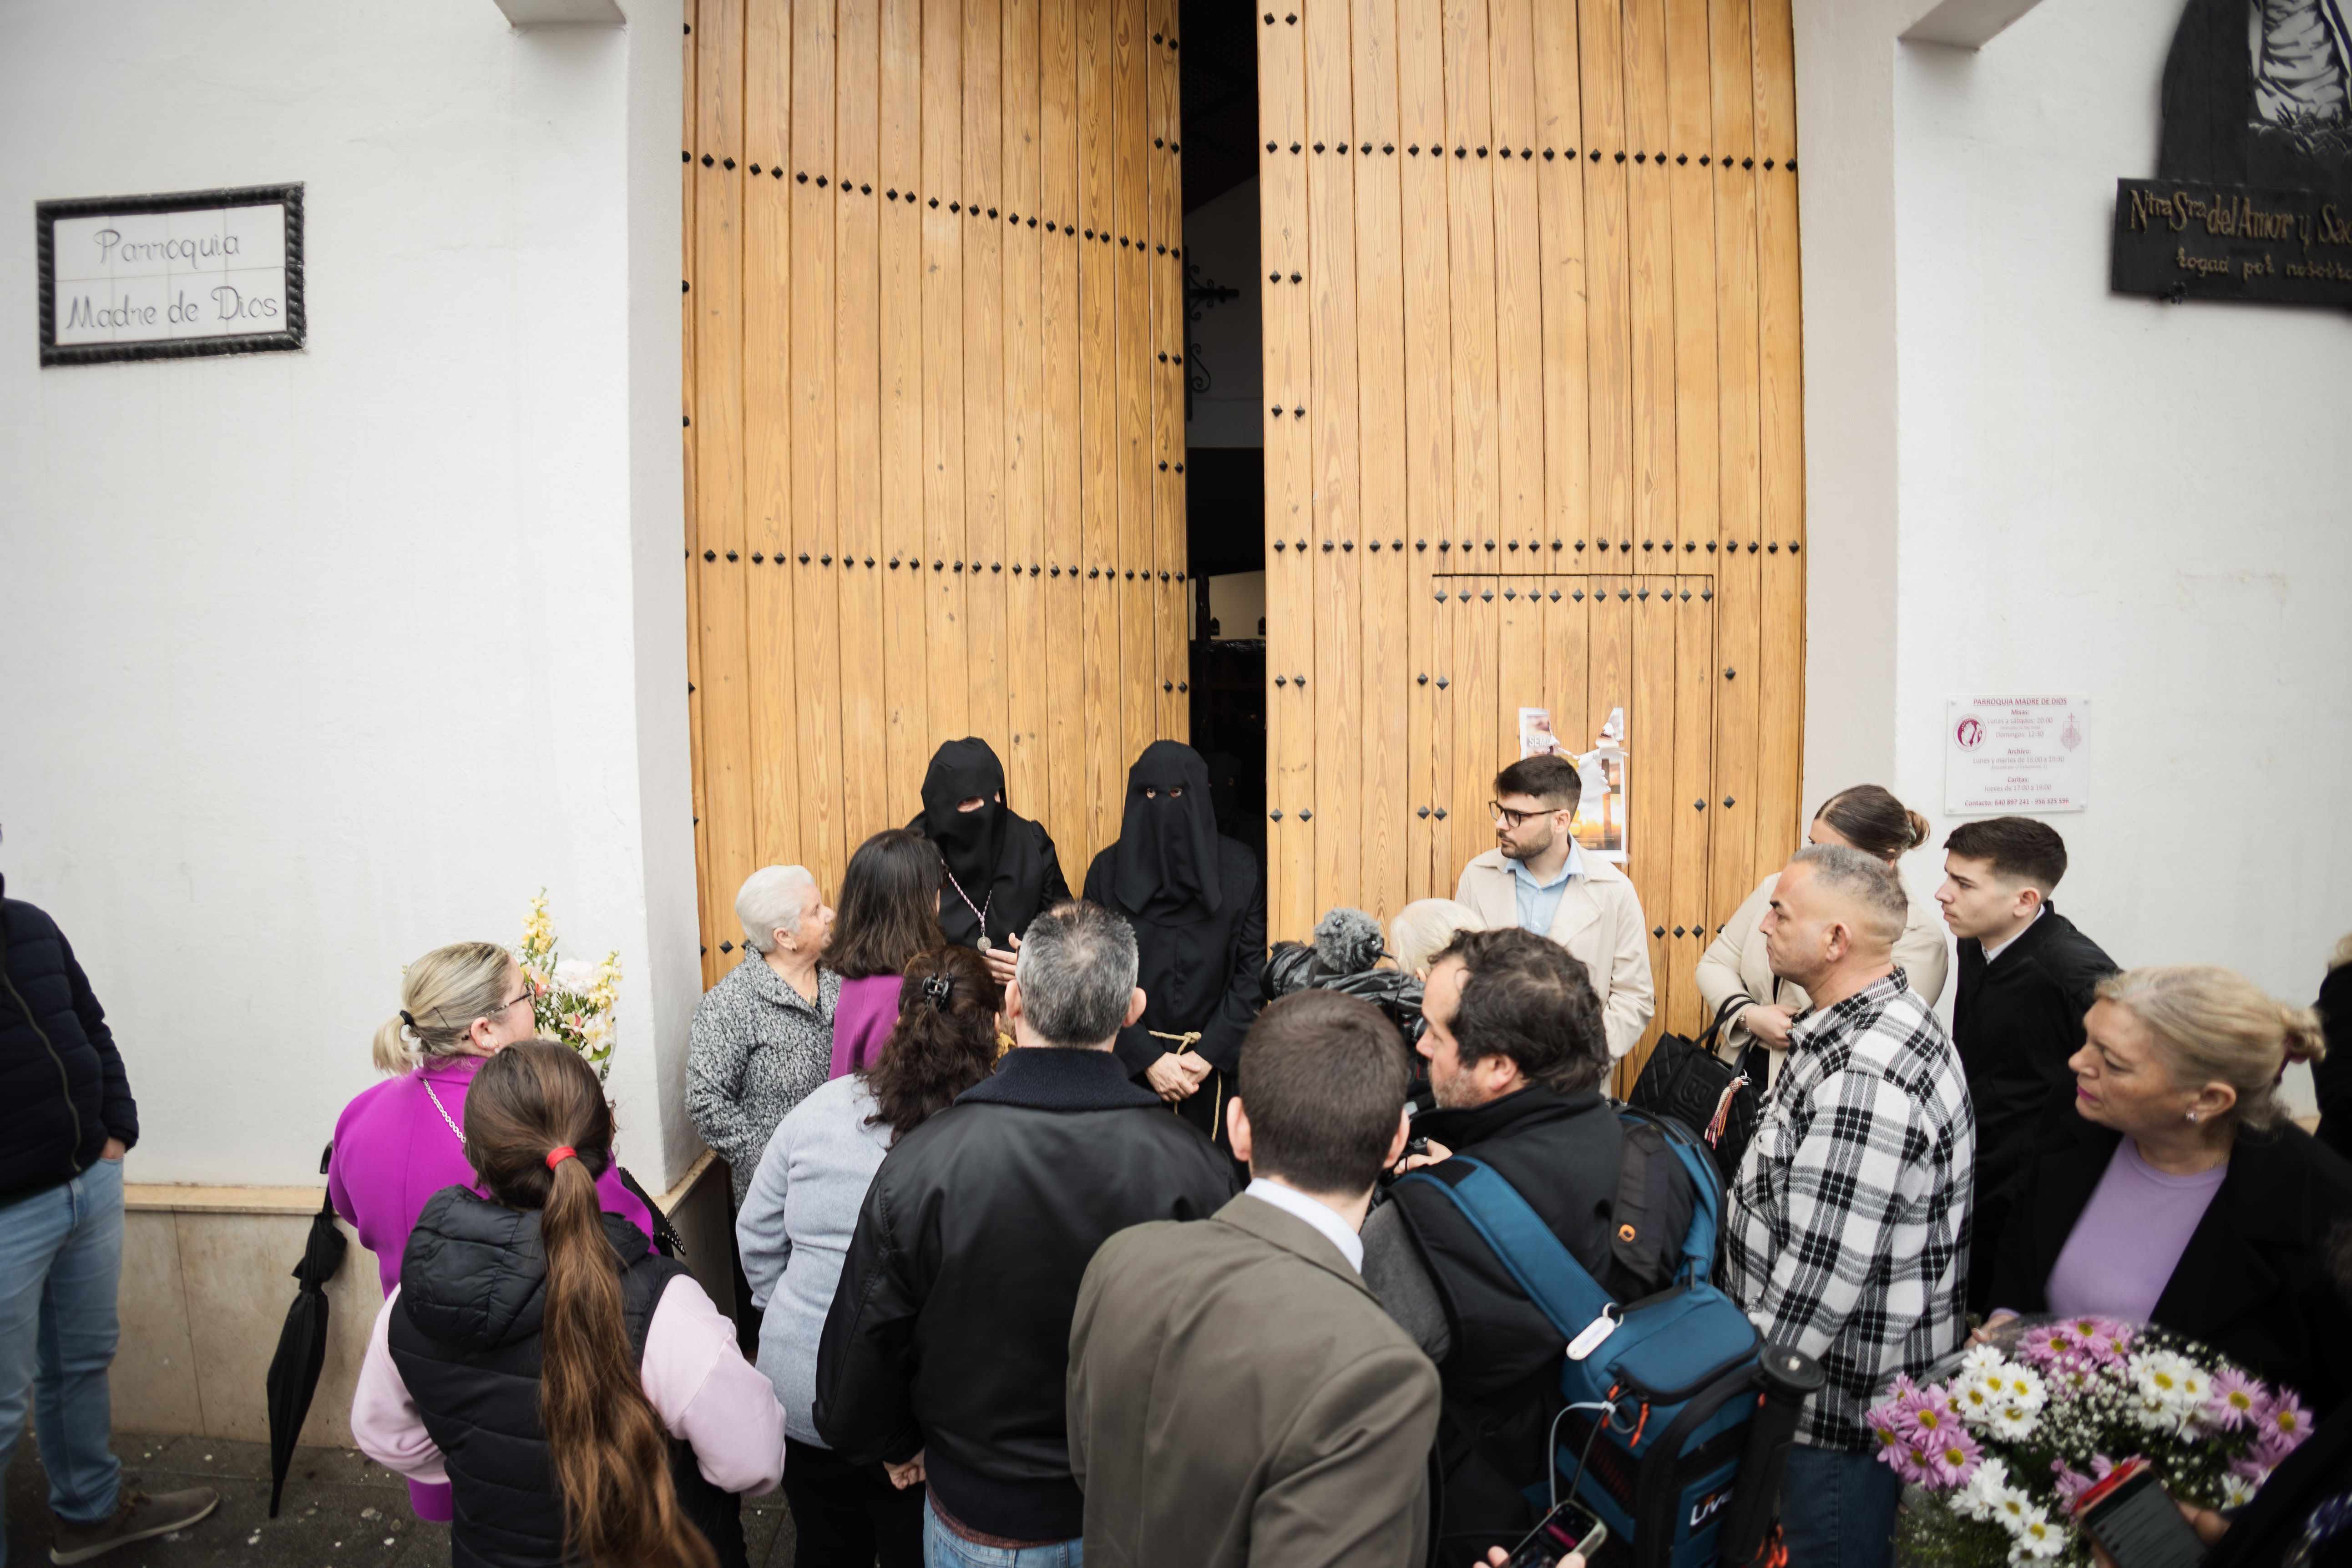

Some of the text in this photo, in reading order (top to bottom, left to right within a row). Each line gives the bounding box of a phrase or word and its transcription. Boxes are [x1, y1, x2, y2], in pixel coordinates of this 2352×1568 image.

[93, 228, 241, 270] Parroquia
[65, 285, 278, 329] Madre de Dios
